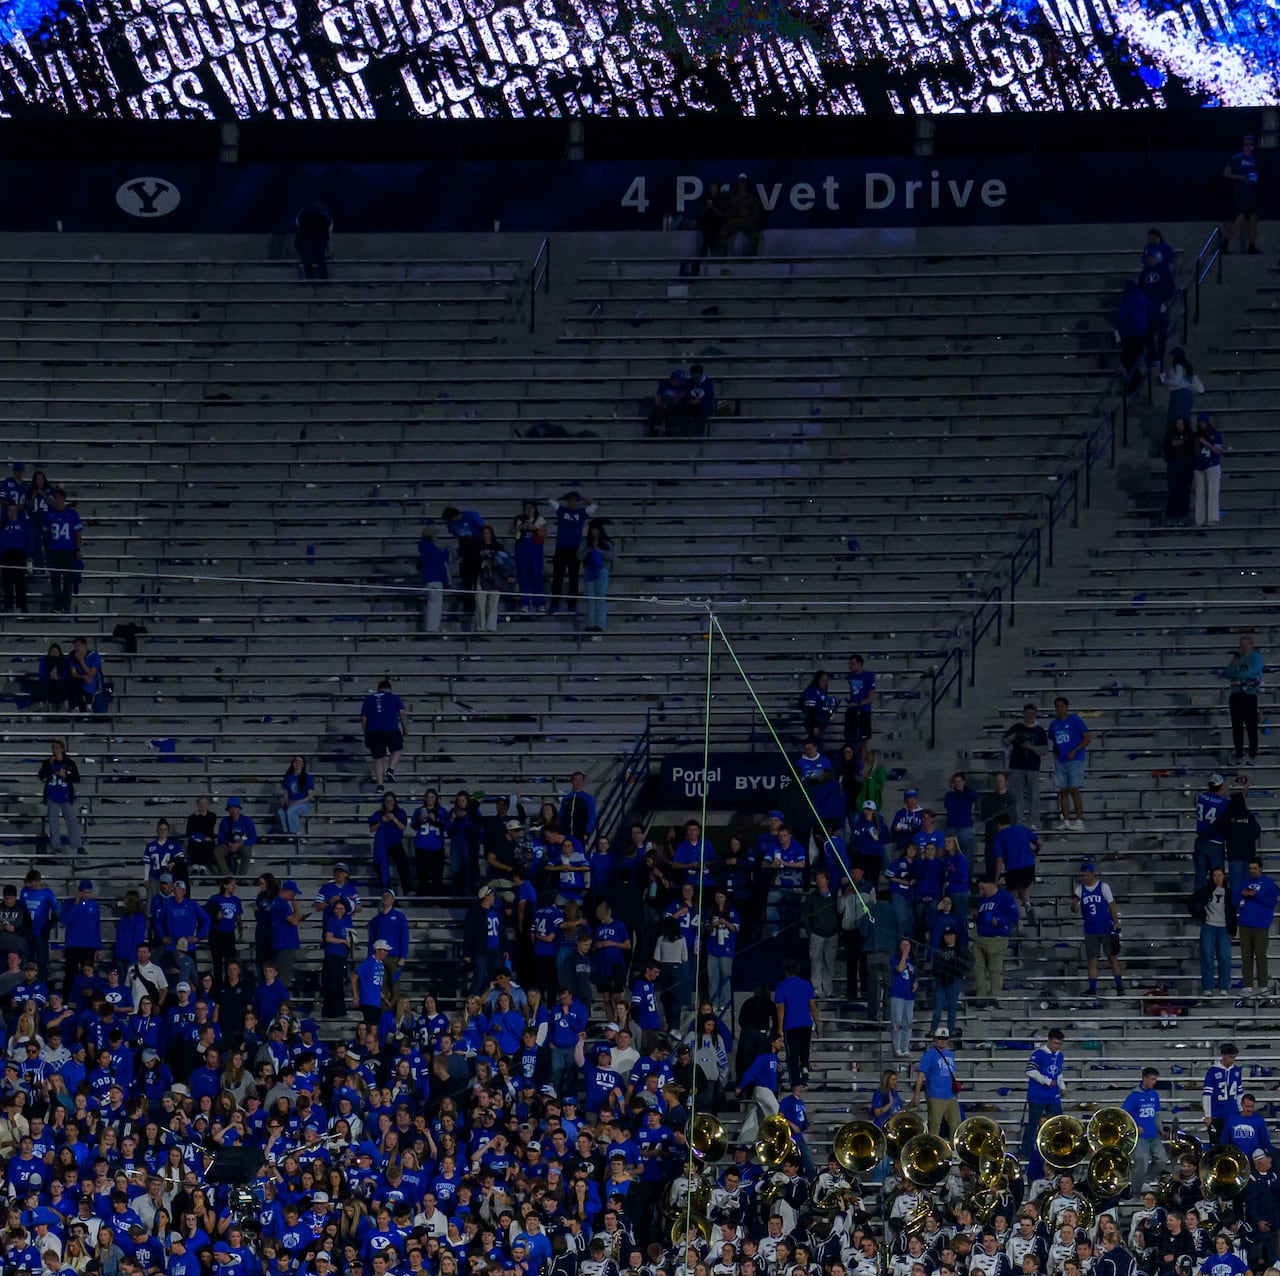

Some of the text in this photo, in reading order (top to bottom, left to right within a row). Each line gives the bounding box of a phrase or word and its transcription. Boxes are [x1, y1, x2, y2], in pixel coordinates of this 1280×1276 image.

[620, 170, 1008, 213] 4 Pvet Drive
[735, 776, 776, 790] BYU
[151, 853, 172, 870] 34
[1083, 895, 1102, 904] BYU
[1089, 904, 1097, 916] 3
[596, 1072, 616, 1085] BYU
[1218, 1083, 1238, 1101] 34
[1138, 1106, 1155, 1118] 250
[136, 1249, 151, 1261] BYU
